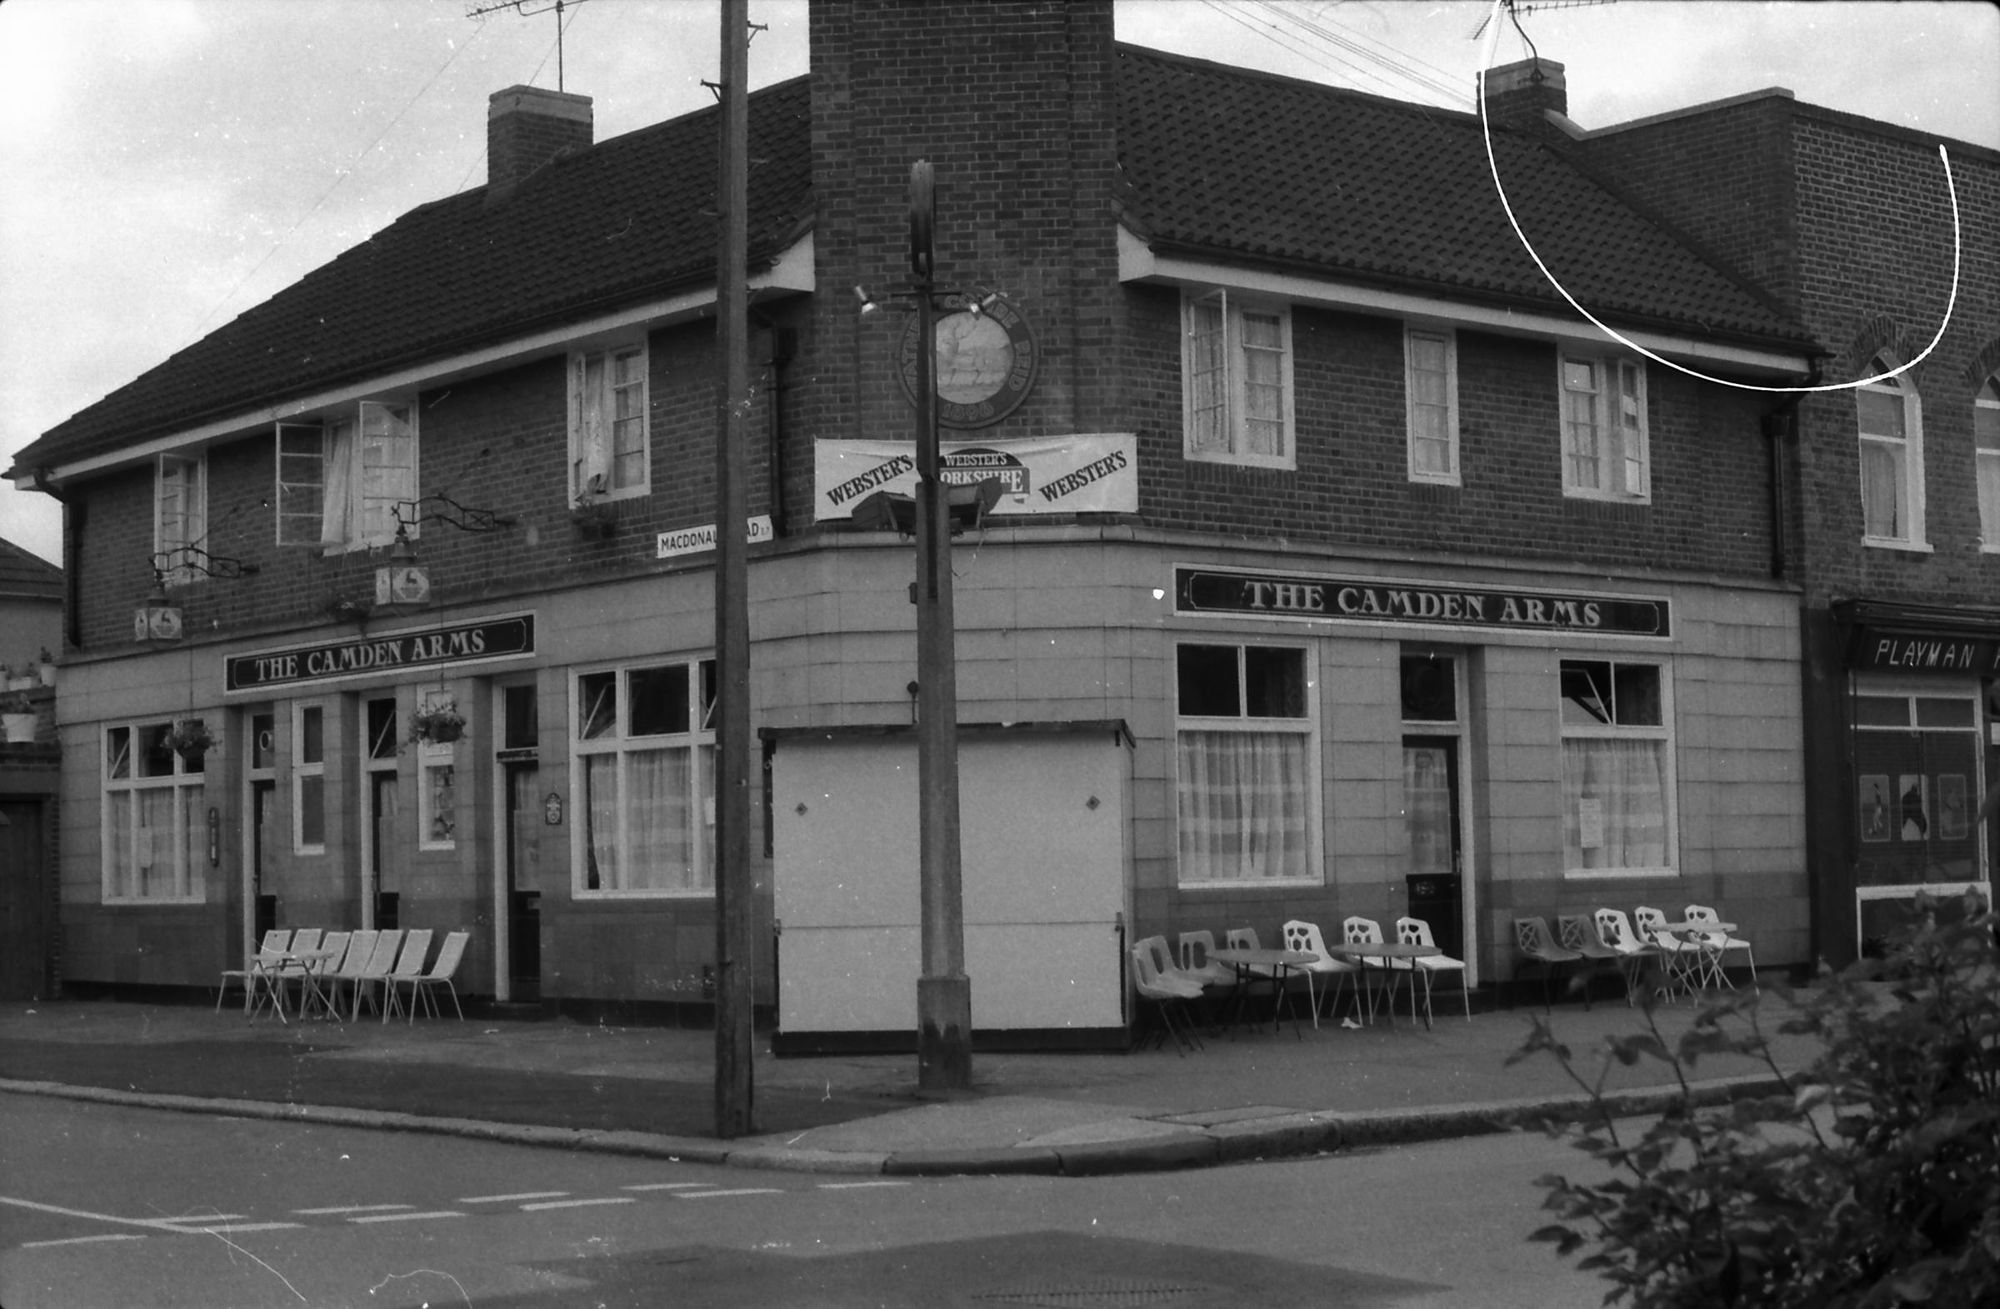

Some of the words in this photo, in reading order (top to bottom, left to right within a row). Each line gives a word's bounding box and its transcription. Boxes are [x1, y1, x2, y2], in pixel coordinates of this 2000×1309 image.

[1008, 340, 1031, 391] REID
[826, 454, 914, 506] WEBSTER'S
[944, 452, 1008, 466] WEBSTER'S
[1038, 450, 1128, 502] WEBSTER'S
[661, 530, 717, 551] MACDONAL
[1243, 580, 1325, 612] THE
[1337, 587, 1486, 621] CAMDEN
[1499, 598, 1602, 627] ARMS
[254, 655, 299, 682] THE
[307, 639, 404, 675] CAMDEN
[410, 629, 486, 661] ARMS
[1874, 639, 1976, 668] PLAYMAN
